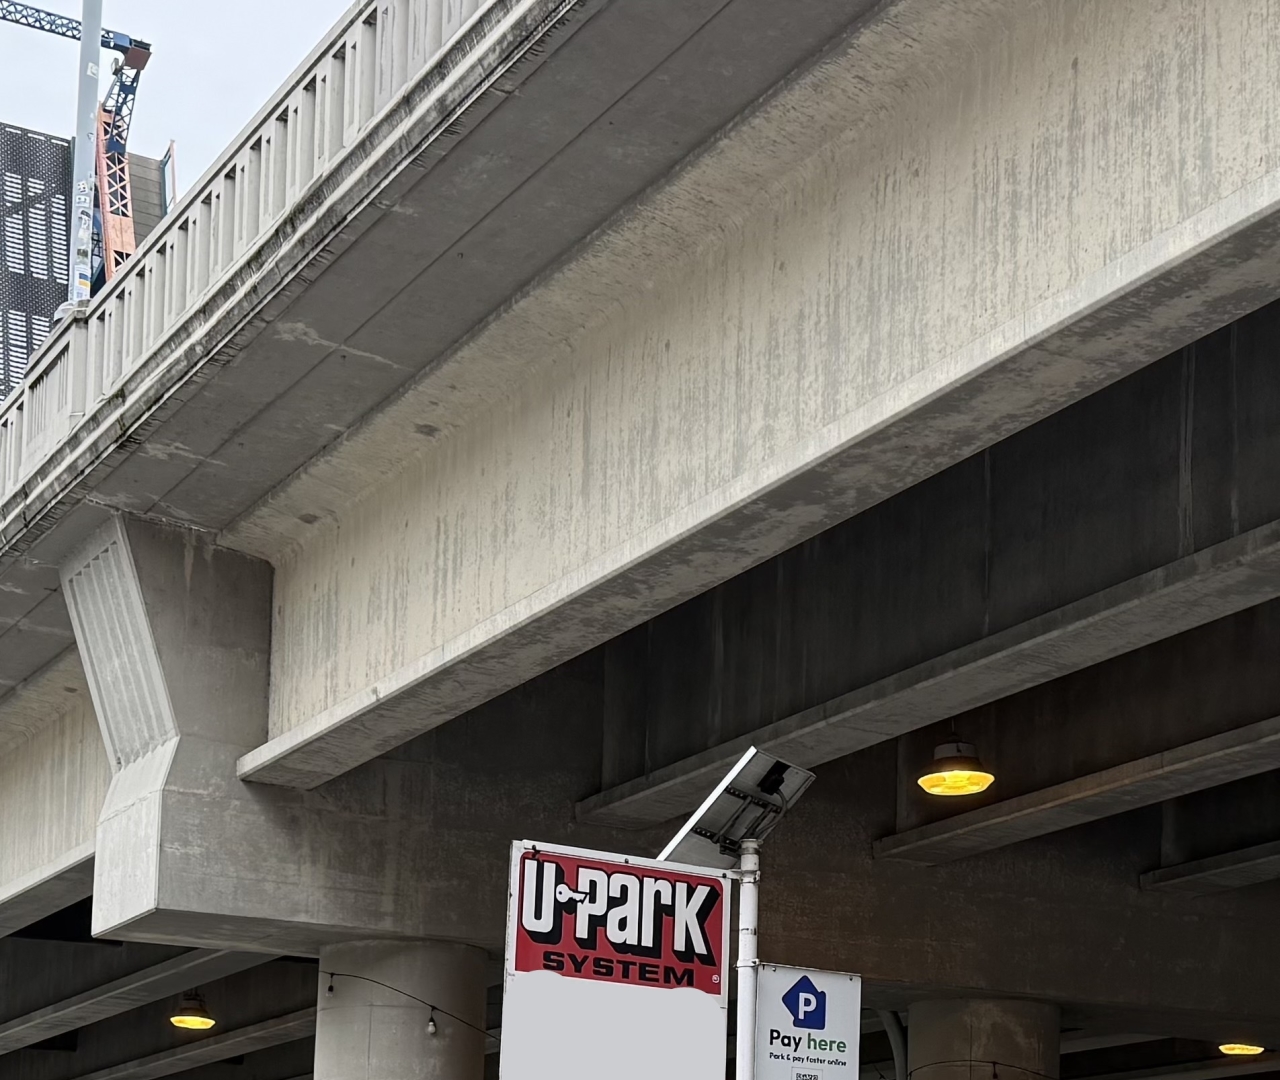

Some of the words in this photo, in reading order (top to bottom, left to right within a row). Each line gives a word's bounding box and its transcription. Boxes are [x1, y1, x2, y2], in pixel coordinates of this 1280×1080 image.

[543, 951, 695, 986] SYSTEM
[799, 992, 817, 1020] P
[769, 1029, 802, 1052] Pay
[807, 1032, 847, 1053] here
[769, 1052, 785, 1060] Park
[792, 1055, 804, 1063] pay
